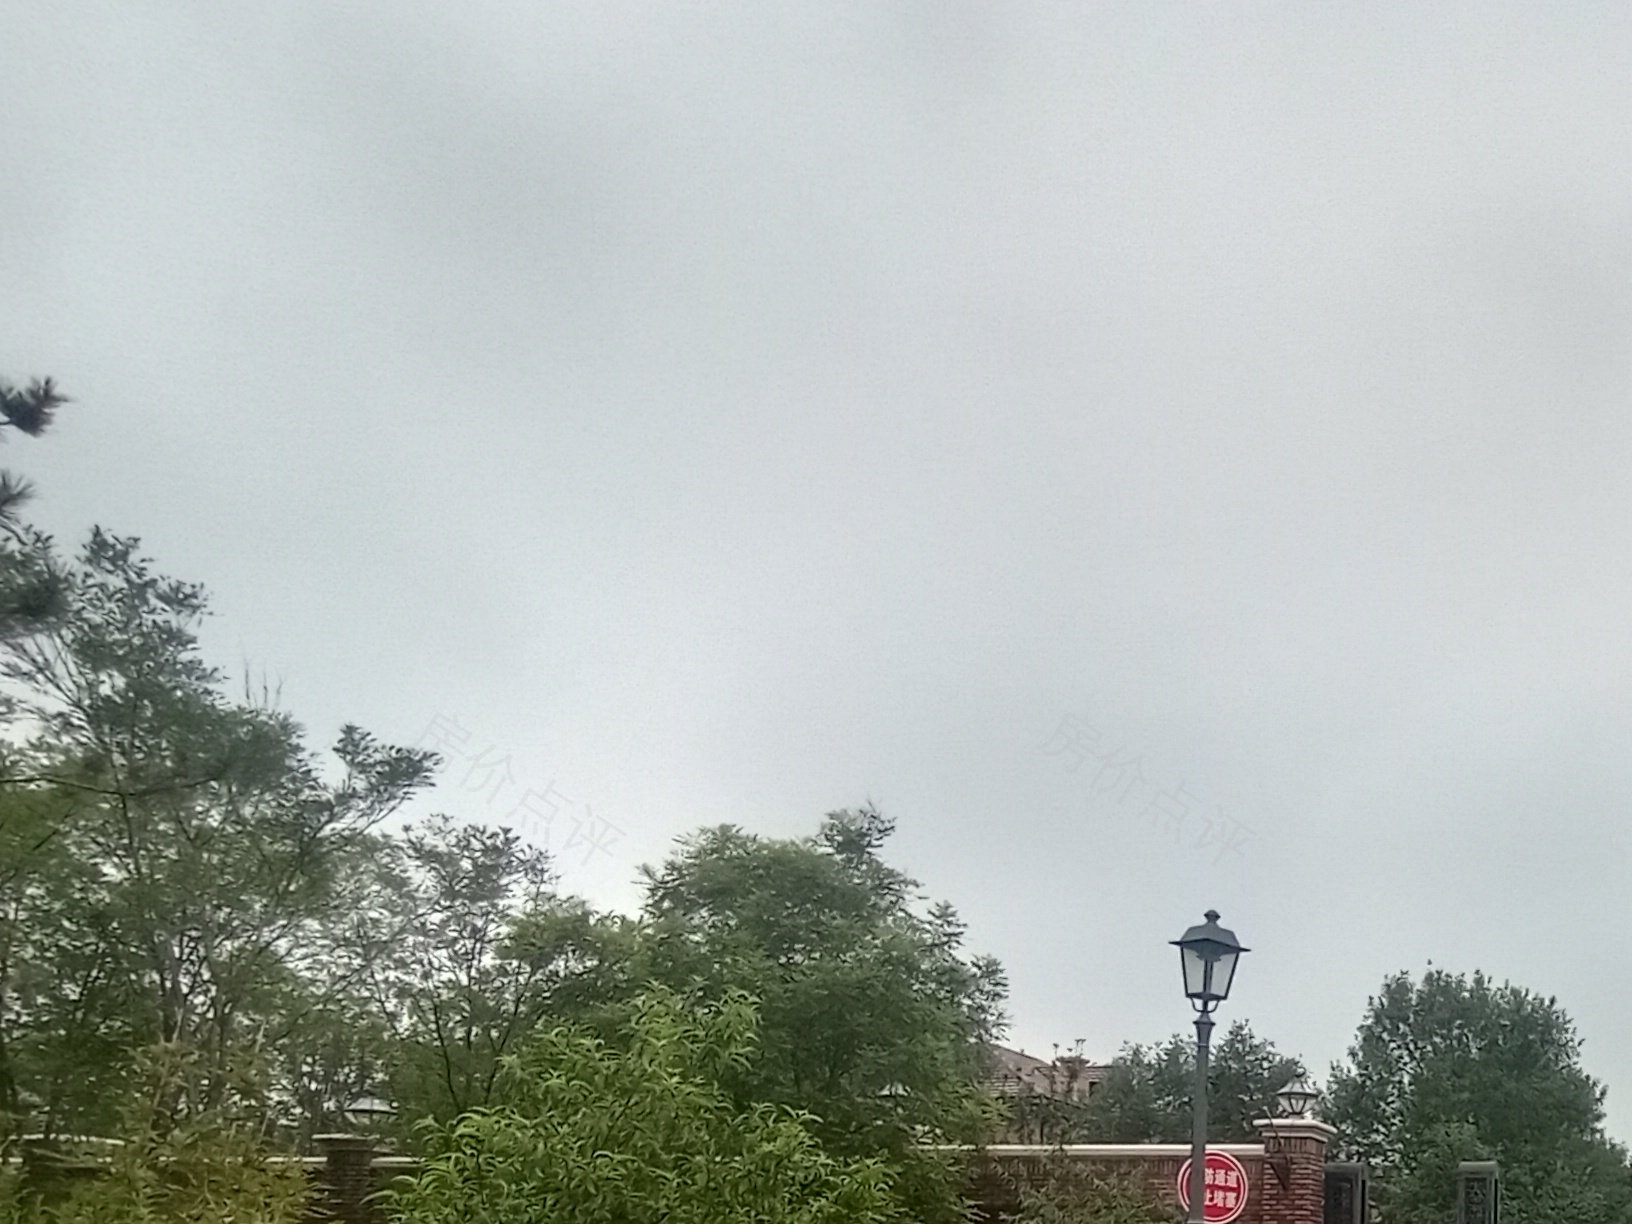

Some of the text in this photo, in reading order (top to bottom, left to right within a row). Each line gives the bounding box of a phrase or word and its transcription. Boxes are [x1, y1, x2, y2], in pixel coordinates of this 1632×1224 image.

[1205, 1168, 1238, 1187] 防通道
[1204, 1189, 1237, 1207] 止堵塞
